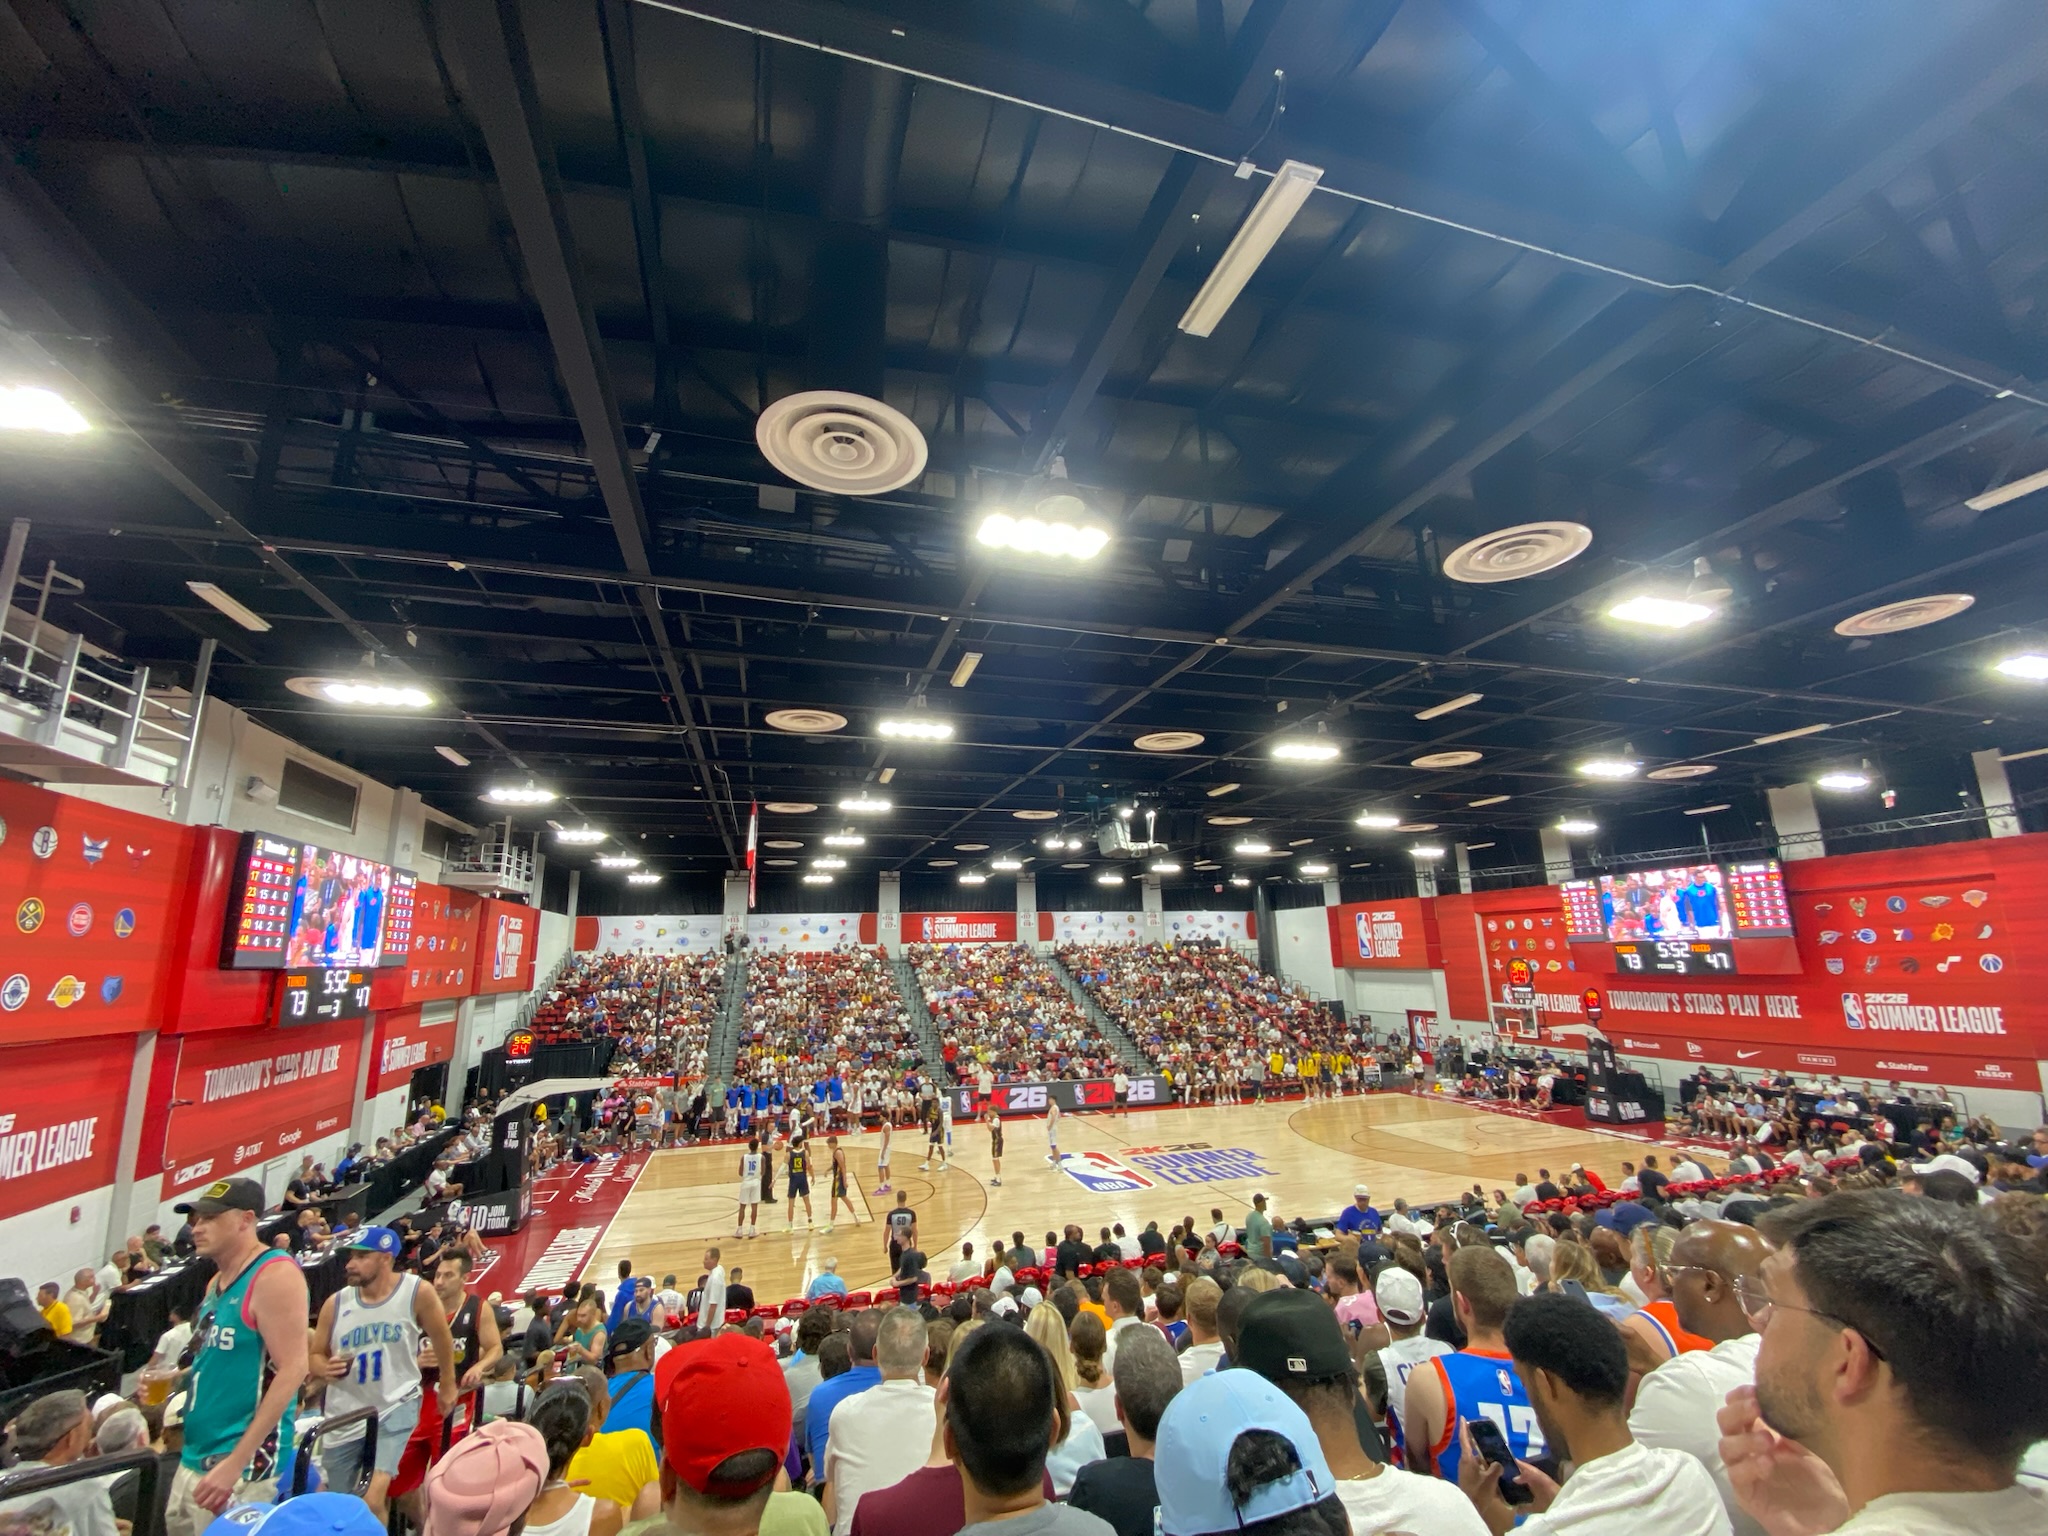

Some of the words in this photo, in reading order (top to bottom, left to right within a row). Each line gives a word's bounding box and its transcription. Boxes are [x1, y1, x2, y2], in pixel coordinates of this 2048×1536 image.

[251, 871, 259, 881] 17
[262, 873, 271, 884] 12
[275, 874, 280, 884] 7
[285, 876, 291, 886] 3
[247, 887, 257, 897] 23
[260, 889, 269, 900] 15
[271, 890, 277, 900] 4
[283, 892, 289, 901] 0
[244, 903, 254, 913] 25
[257, 904, 266, 914] 10
[269, 906, 275, 915] 5
[280, 907, 286, 916] 4
[242, 919, 252, 929] 40
[254, 920, 263, 930] 14
[267, 921, 273, 931] 2
[280, 923, 284, 932] 1
[934, 923, 968, 939] SUMMER
[969, 923, 997, 938] LEAGUE
[1373, 922, 1404, 940] SUMMER
[239, 935, 249, 945] 44
[252, 936, 259, 946] 4
[265, 938, 270, 947] 1
[276, 938, 282, 948] 2
[1374, 940, 1401, 958] LEAGUE
[1657, 942, 1691, 958] 5:52
[1622, 954, 1643, 969] 73
[1705, 952, 1730, 969] 47
[1676, 960, 1687, 973] 3
[322, 970, 350, 993] 5:52
[290, 990, 309, 1016] 73
[356, 986, 371, 1007] 47
[1549, 994, 1583, 1014] LEAGUE
[1606, 990, 1681, 1013] TOMORROW'S
[1684, 993, 1725, 1015] STARS
[1727, 994, 1760, 1017] PLAY
[1764, 995, 1802, 1018] HERE
[1864, 993, 1909, 1004] 2K26
[332, 999, 341, 1017] 3
[1866, 1005, 1940, 1032] SUMMER
[1938, 1006, 2007, 1035] LEAGUE
[389, 1046, 410, 1071] SUMMER
[409, 1041, 428, 1066] LEAGUE
[511, 1044, 527, 1055] 24
[1801, 1056, 1834, 1064] PANINI
[203, 1058, 272, 1103] TOMORROW'S
[274, 1052, 301, 1086] STARS
[301, 1049, 322, 1078] PLAY
[321, 1045, 341, 1073] HERE
[1974, 1070, 2013, 1078] TISSOT
[508, 1122, 519, 1130] GET
[278, 1128, 302, 1146] Google
[507, 1130, 517, 1139] THE
[36, 1117, 98, 1172] LEAGUE
[244, 1141, 264, 1157] AT&T
[509, 1139, 519, 1149] App
[1118, 1142, 1214, 1156] 2K26
[748, 1160, 756, 1172] 16
[794, 1158, 803, 1169] 13
[1130, 1148, 1268, 1171] SUMMER
[1152, 1161, 1280, 1185] LEAGUE
[1093, 1180, 1131, 1191] NBA
[488, 1205, 507, 1217] JOIN
[487, 1216, 511, 1230] TODAY
[896, 1216, 907, 1226] 50
[339, 1321, 403, 1348] WOLVES
[356, 1349, 383, 1384] 11
